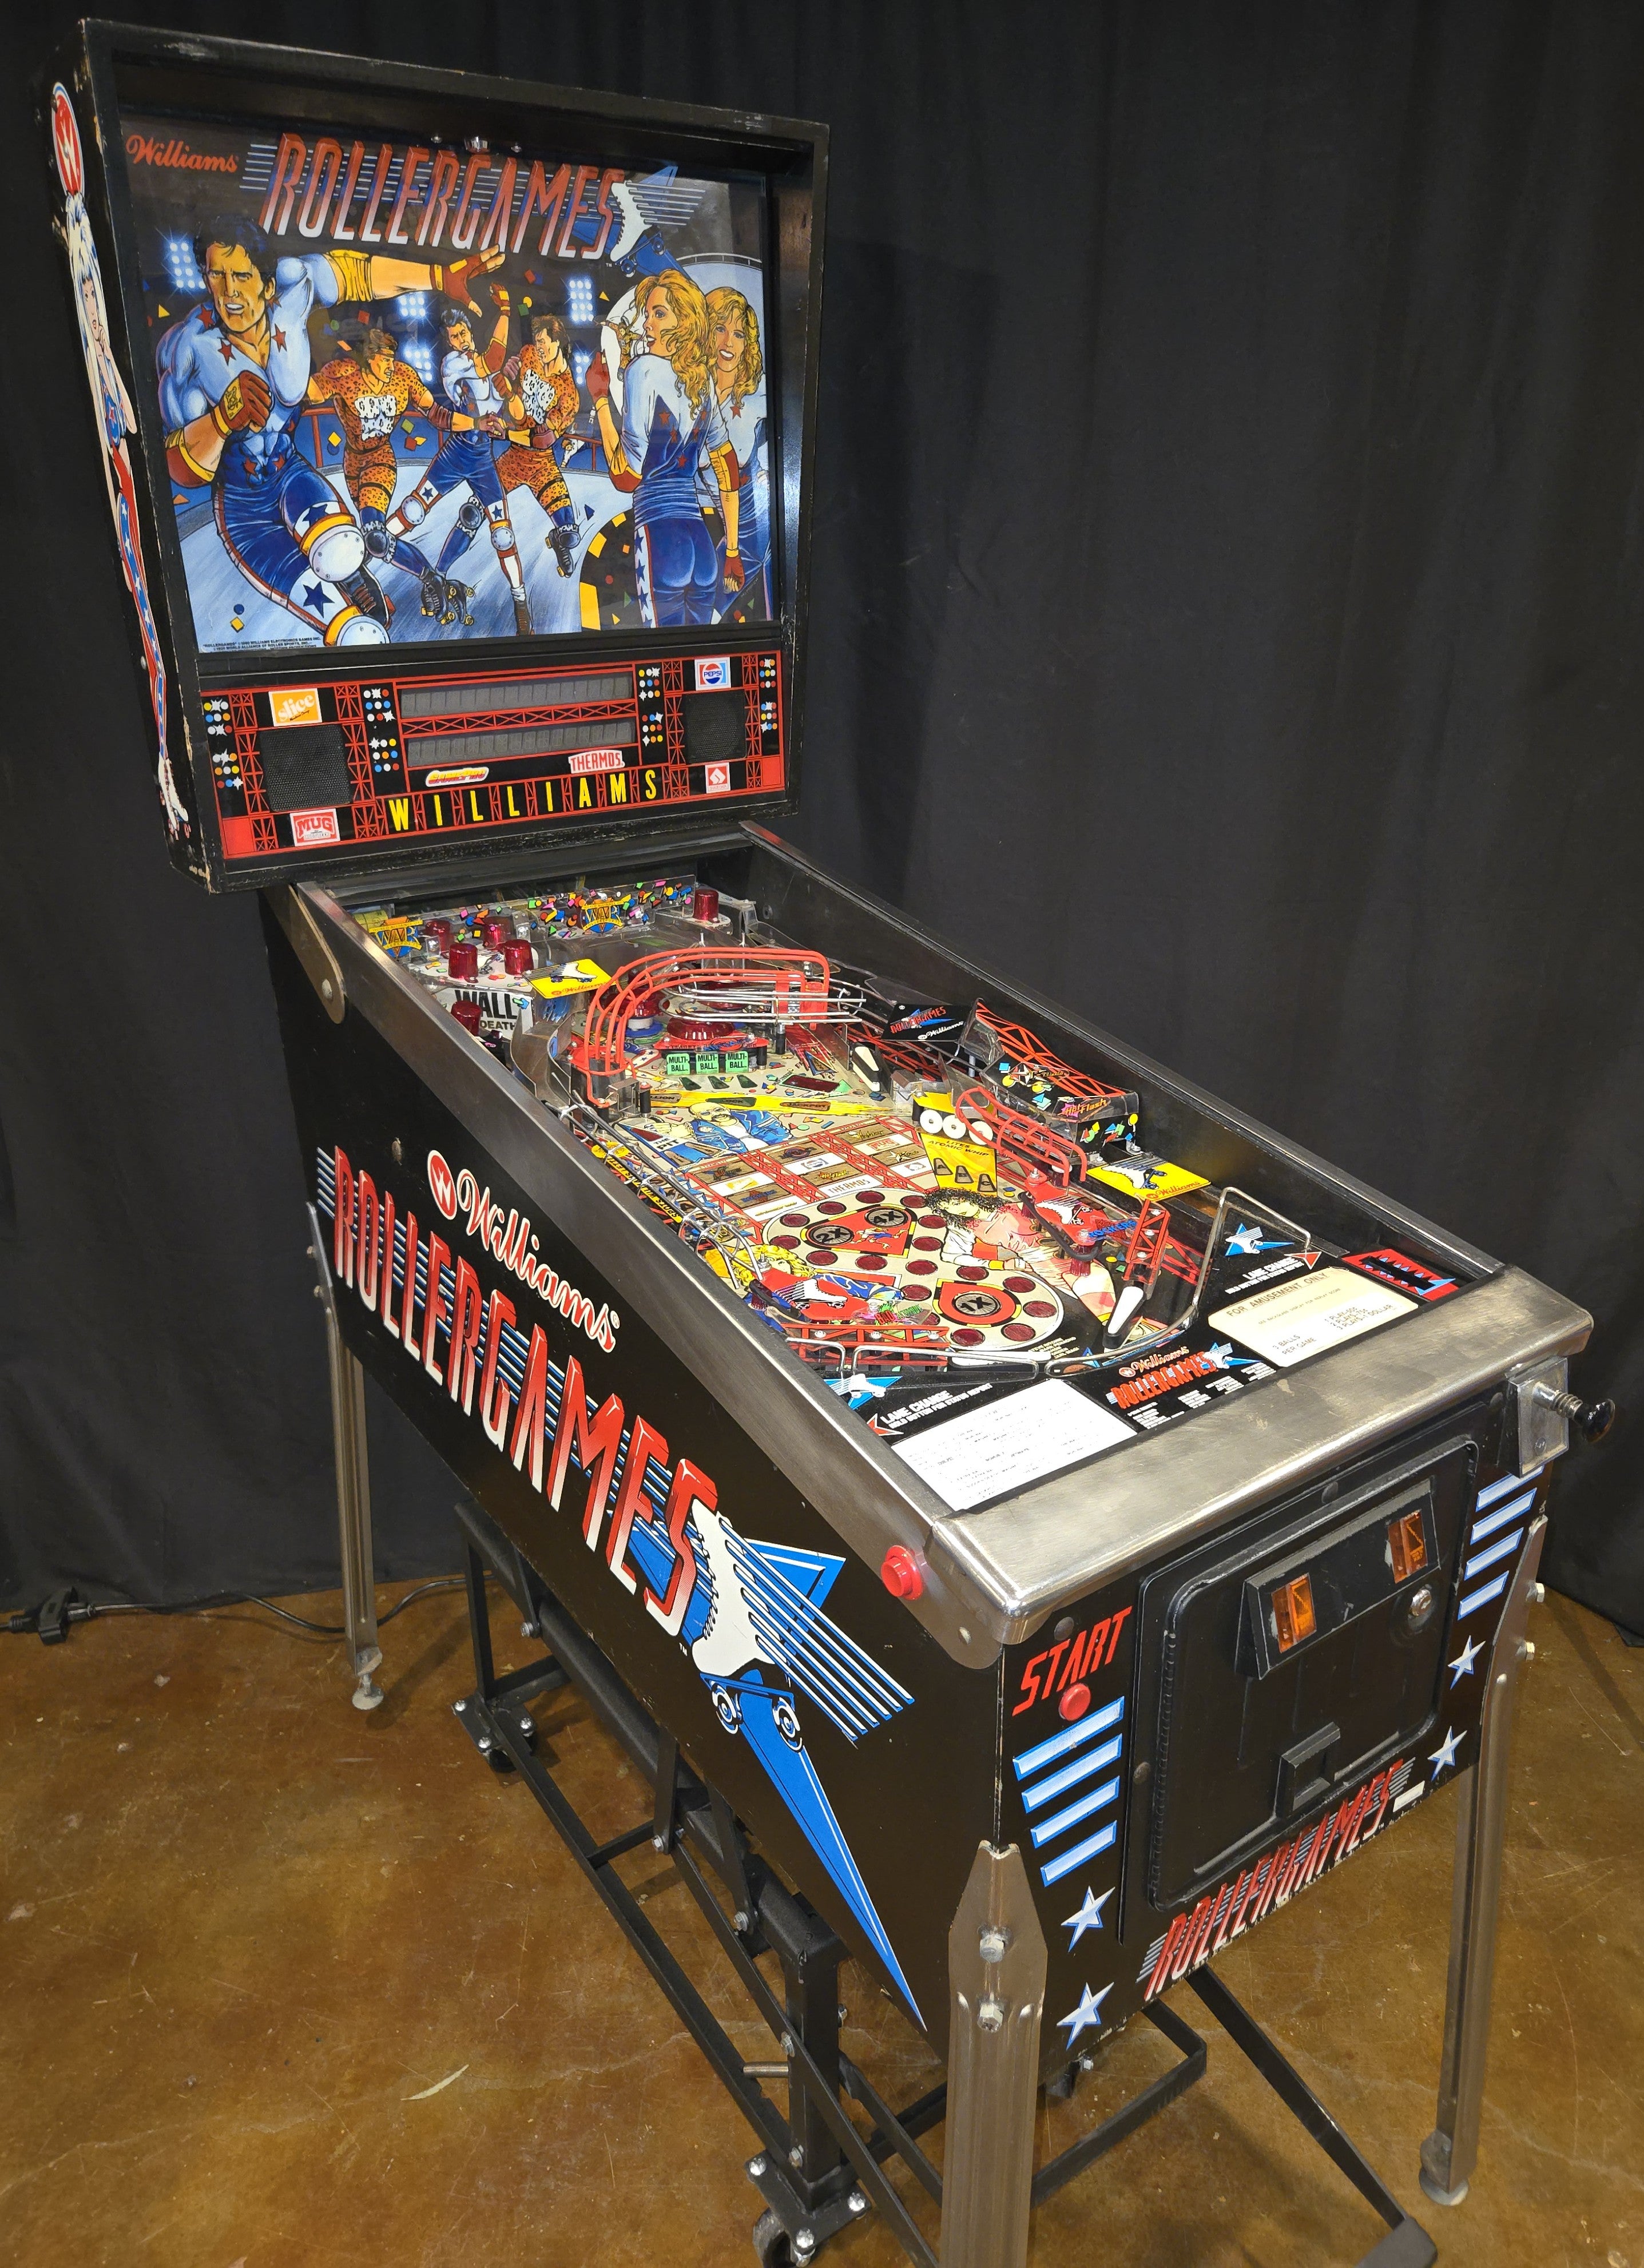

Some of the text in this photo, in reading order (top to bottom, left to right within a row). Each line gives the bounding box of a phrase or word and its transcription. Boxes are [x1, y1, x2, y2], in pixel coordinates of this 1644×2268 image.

[125, 135, 239, 172] Williams
[258, 133, 625, 260] ROLLERGAMES
[277, 694, 315, 723] slice
[297, 817, 333, 837] MUG
[585, 905, 622, 923] WAR
[375, 926, 420, 946] WAR
[926, 1021, 964, 1037] Williams
[697, 1054, 717, 1062] MULTI-
[1066, 1098, 1107, 1114] Hot Flash
[657, 1139, 680, 1150] PIT
[928, 1141, 963, 1150] ATOMIC
[828, 1178, 871, 1194] THERMOS
[1155, 1181, 1201, 1197] Williams
[873, 1210, 902, 1225] 4X
[816, 1228, 849, 1243] 2X
[1226, 1272, 1328, 1317] FOR AMUSEMENT ONLY
[962, 1296, 993, 1312] 1X
[1368, 1304, 1393, 1316] DOLLAR
[875, 1309, 896, 1325] BAD
[1278, 1334, 1300, 1347] BALLS
[1282, 1337, 1317, 1355] PER GAME
[1130, 1346, 1190, 1371] Williams
[1111, 1351, 1218, 1409] ROLLERGAMES
[334, 1145, 718, 1637] ROLLERGAMES
[880, 1390, 954, 1424] LANE CHANGE
[1012, 1605, 1133, 1717] START
[1143, 1758, 1404, 2002] ROLLERGAMES
